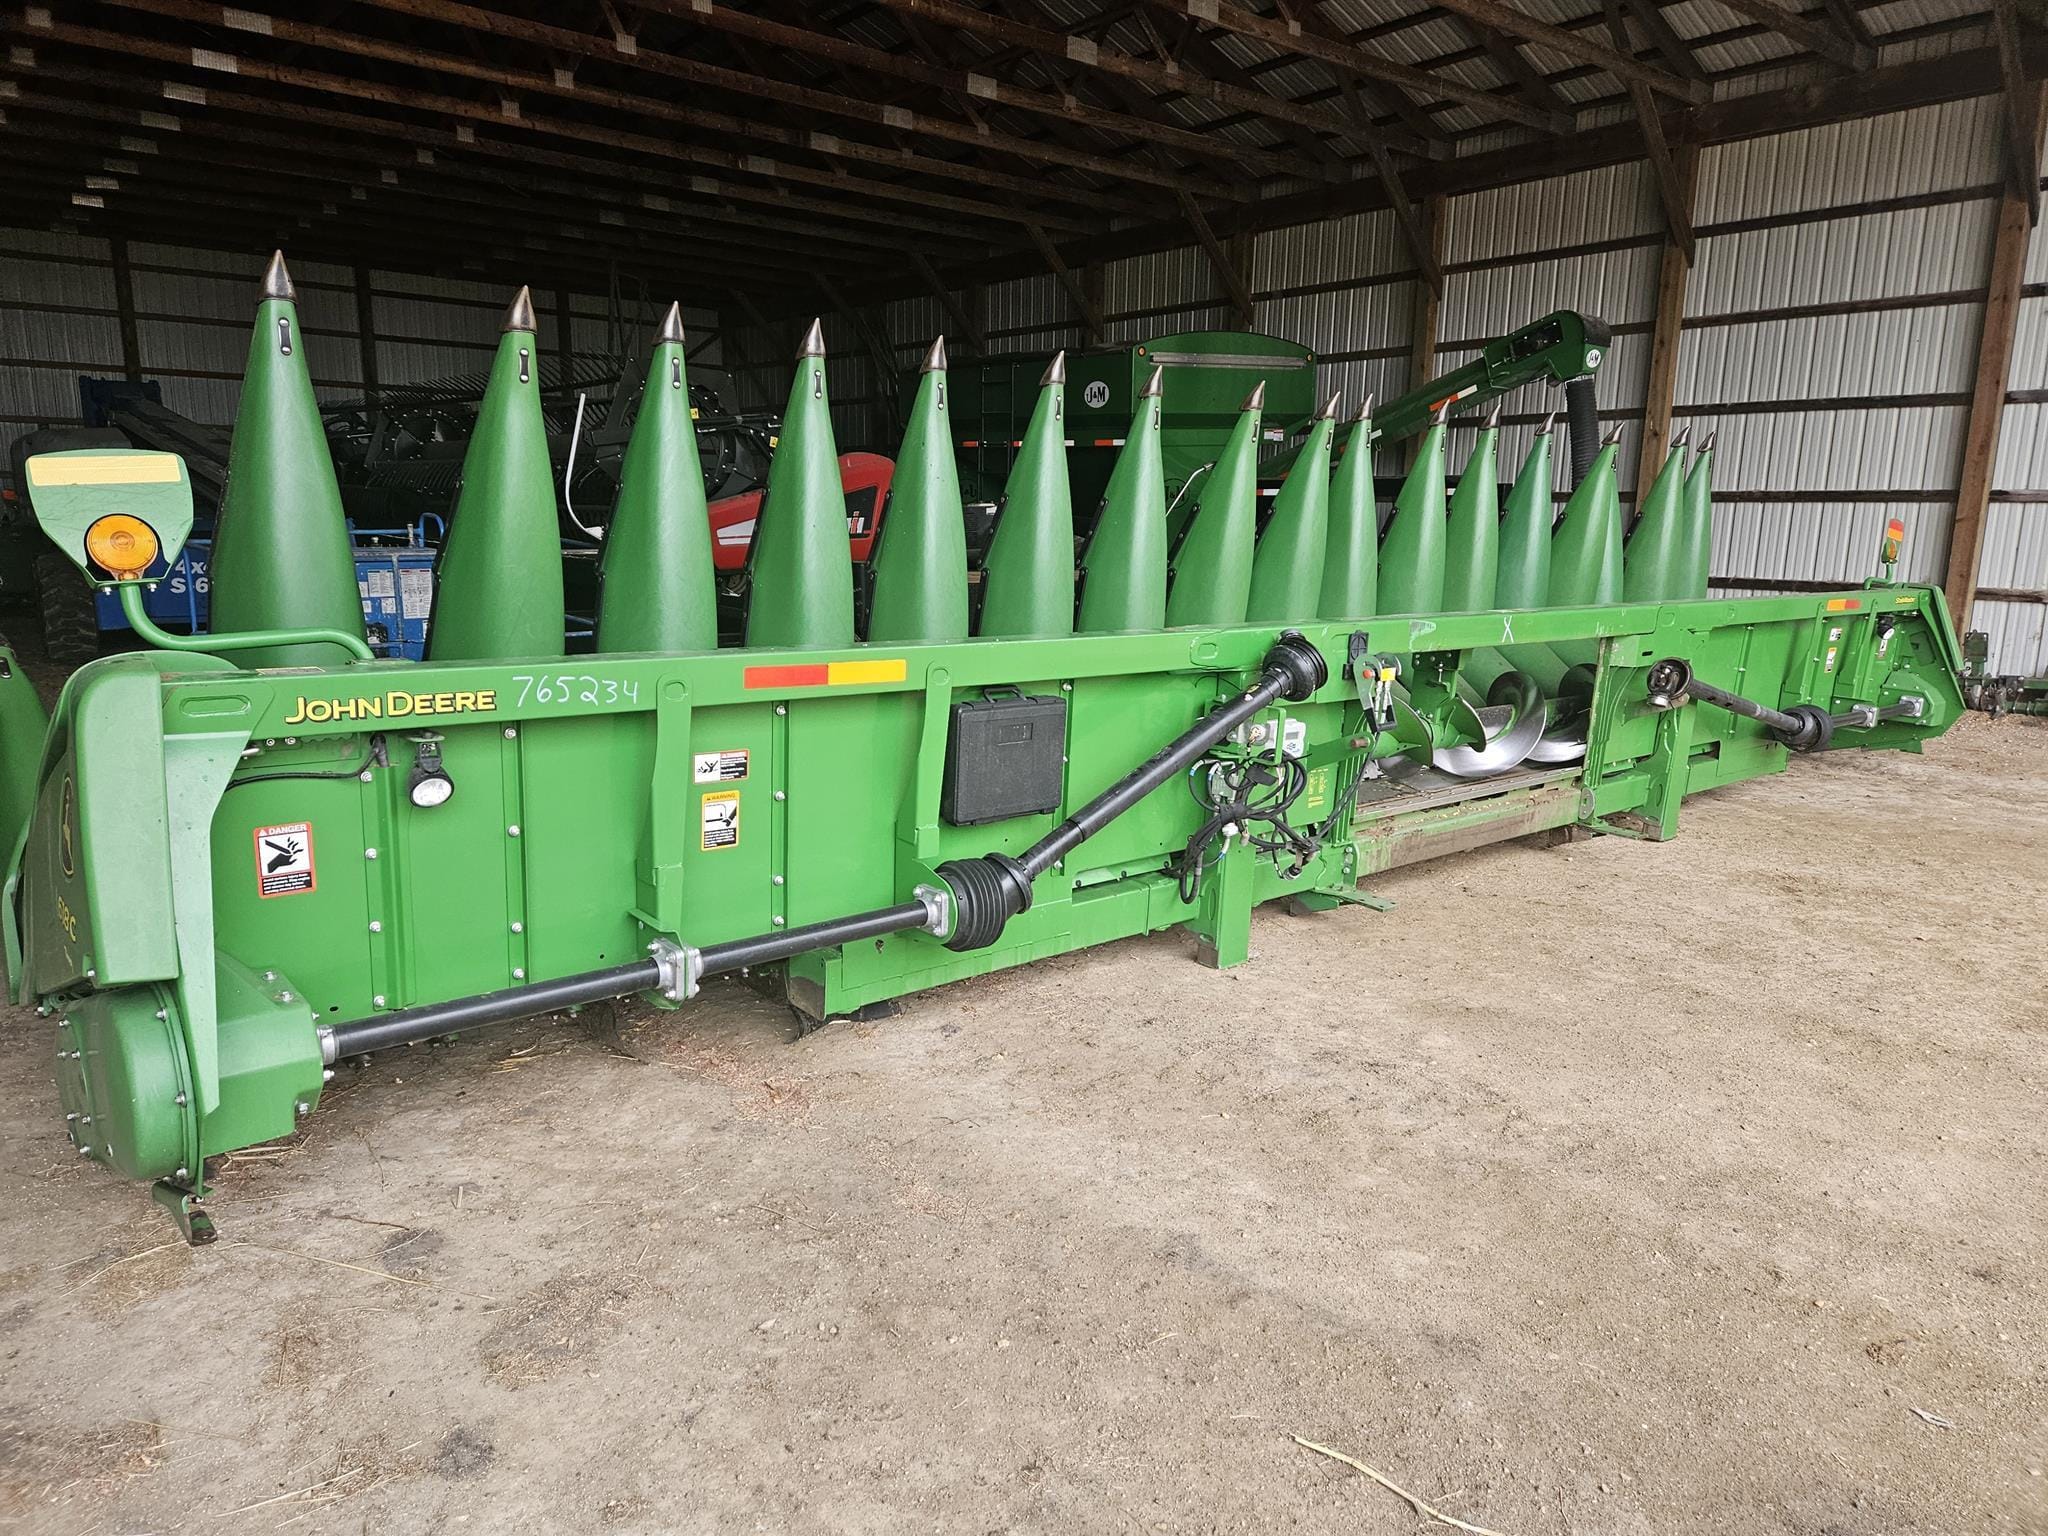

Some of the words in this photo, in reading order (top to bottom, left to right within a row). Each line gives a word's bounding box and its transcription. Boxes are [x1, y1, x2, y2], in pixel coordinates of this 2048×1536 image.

[1086, 386, 1106, 403] J&M
[512, 675, 639, 708] 765234
[284, 696, 383, 725] JOHN
[386, 689, 497, 718] DEERE
[268, 824, 307, 835] DANGER
